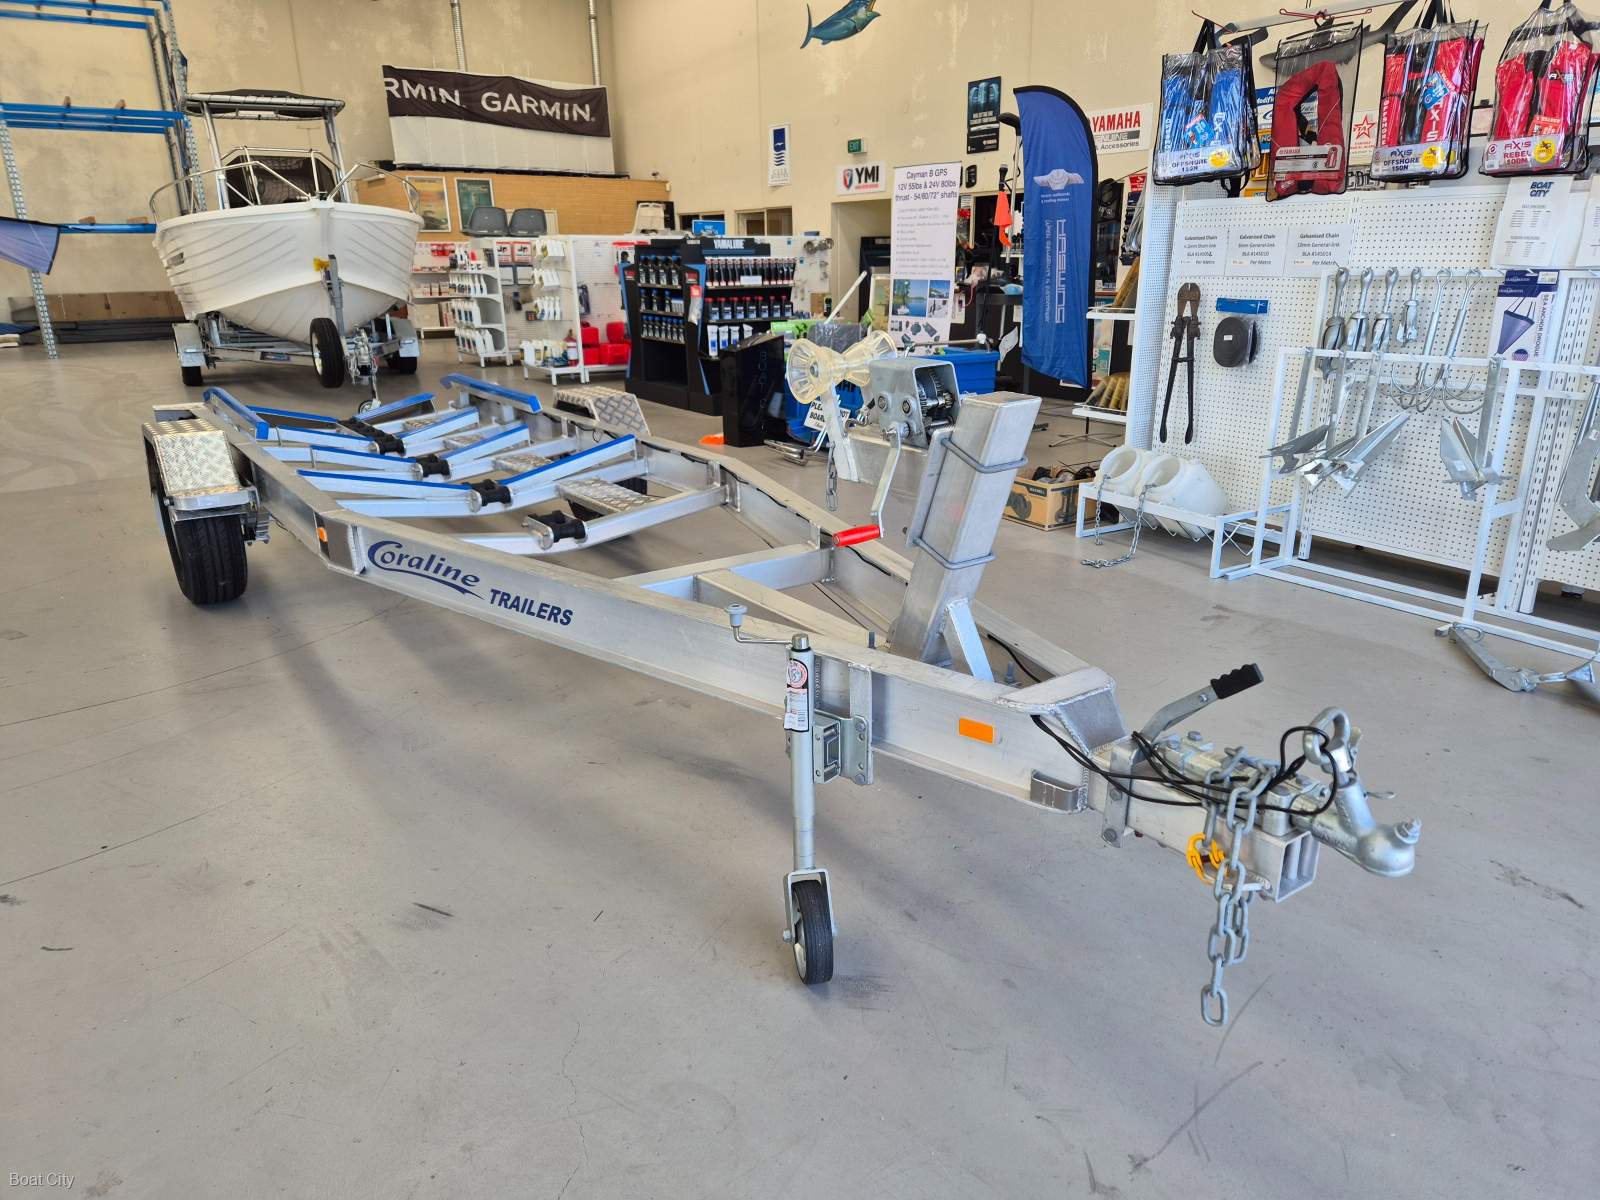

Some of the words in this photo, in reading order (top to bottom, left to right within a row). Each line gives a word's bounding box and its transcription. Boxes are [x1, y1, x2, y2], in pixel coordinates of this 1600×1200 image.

[481, 91, 592, 122] GARMIN
[1092, 110, 1141, 132] YAMAHA
[1101, 141, 1140, 151] Accessories
[1390, 148, 1413, 157] AXIS
[1503, 150, 1531, 158] REBEL
[1171, 159, 1208, 168] OFFSHORE
[1383, 156, 1420, 166] OFFSHORE
[855, 165, 880, 184] YMI
[906, 171, 928, 180] Cayman
[935, 168, 948, 177] GPS
[898, 183, 908, 191] 12V
[908, 182, 922, 190] 55lbs
[929, 180, 940, 189] 24V
[1530, 181, 1554, 190] BOAT
[940, 190, 958, 199] shafts
[1529, 189, 1549, 198] CITY
[368, 540, 480, 590] Coraline
[489, 588, 574, 626] TRAILERS
